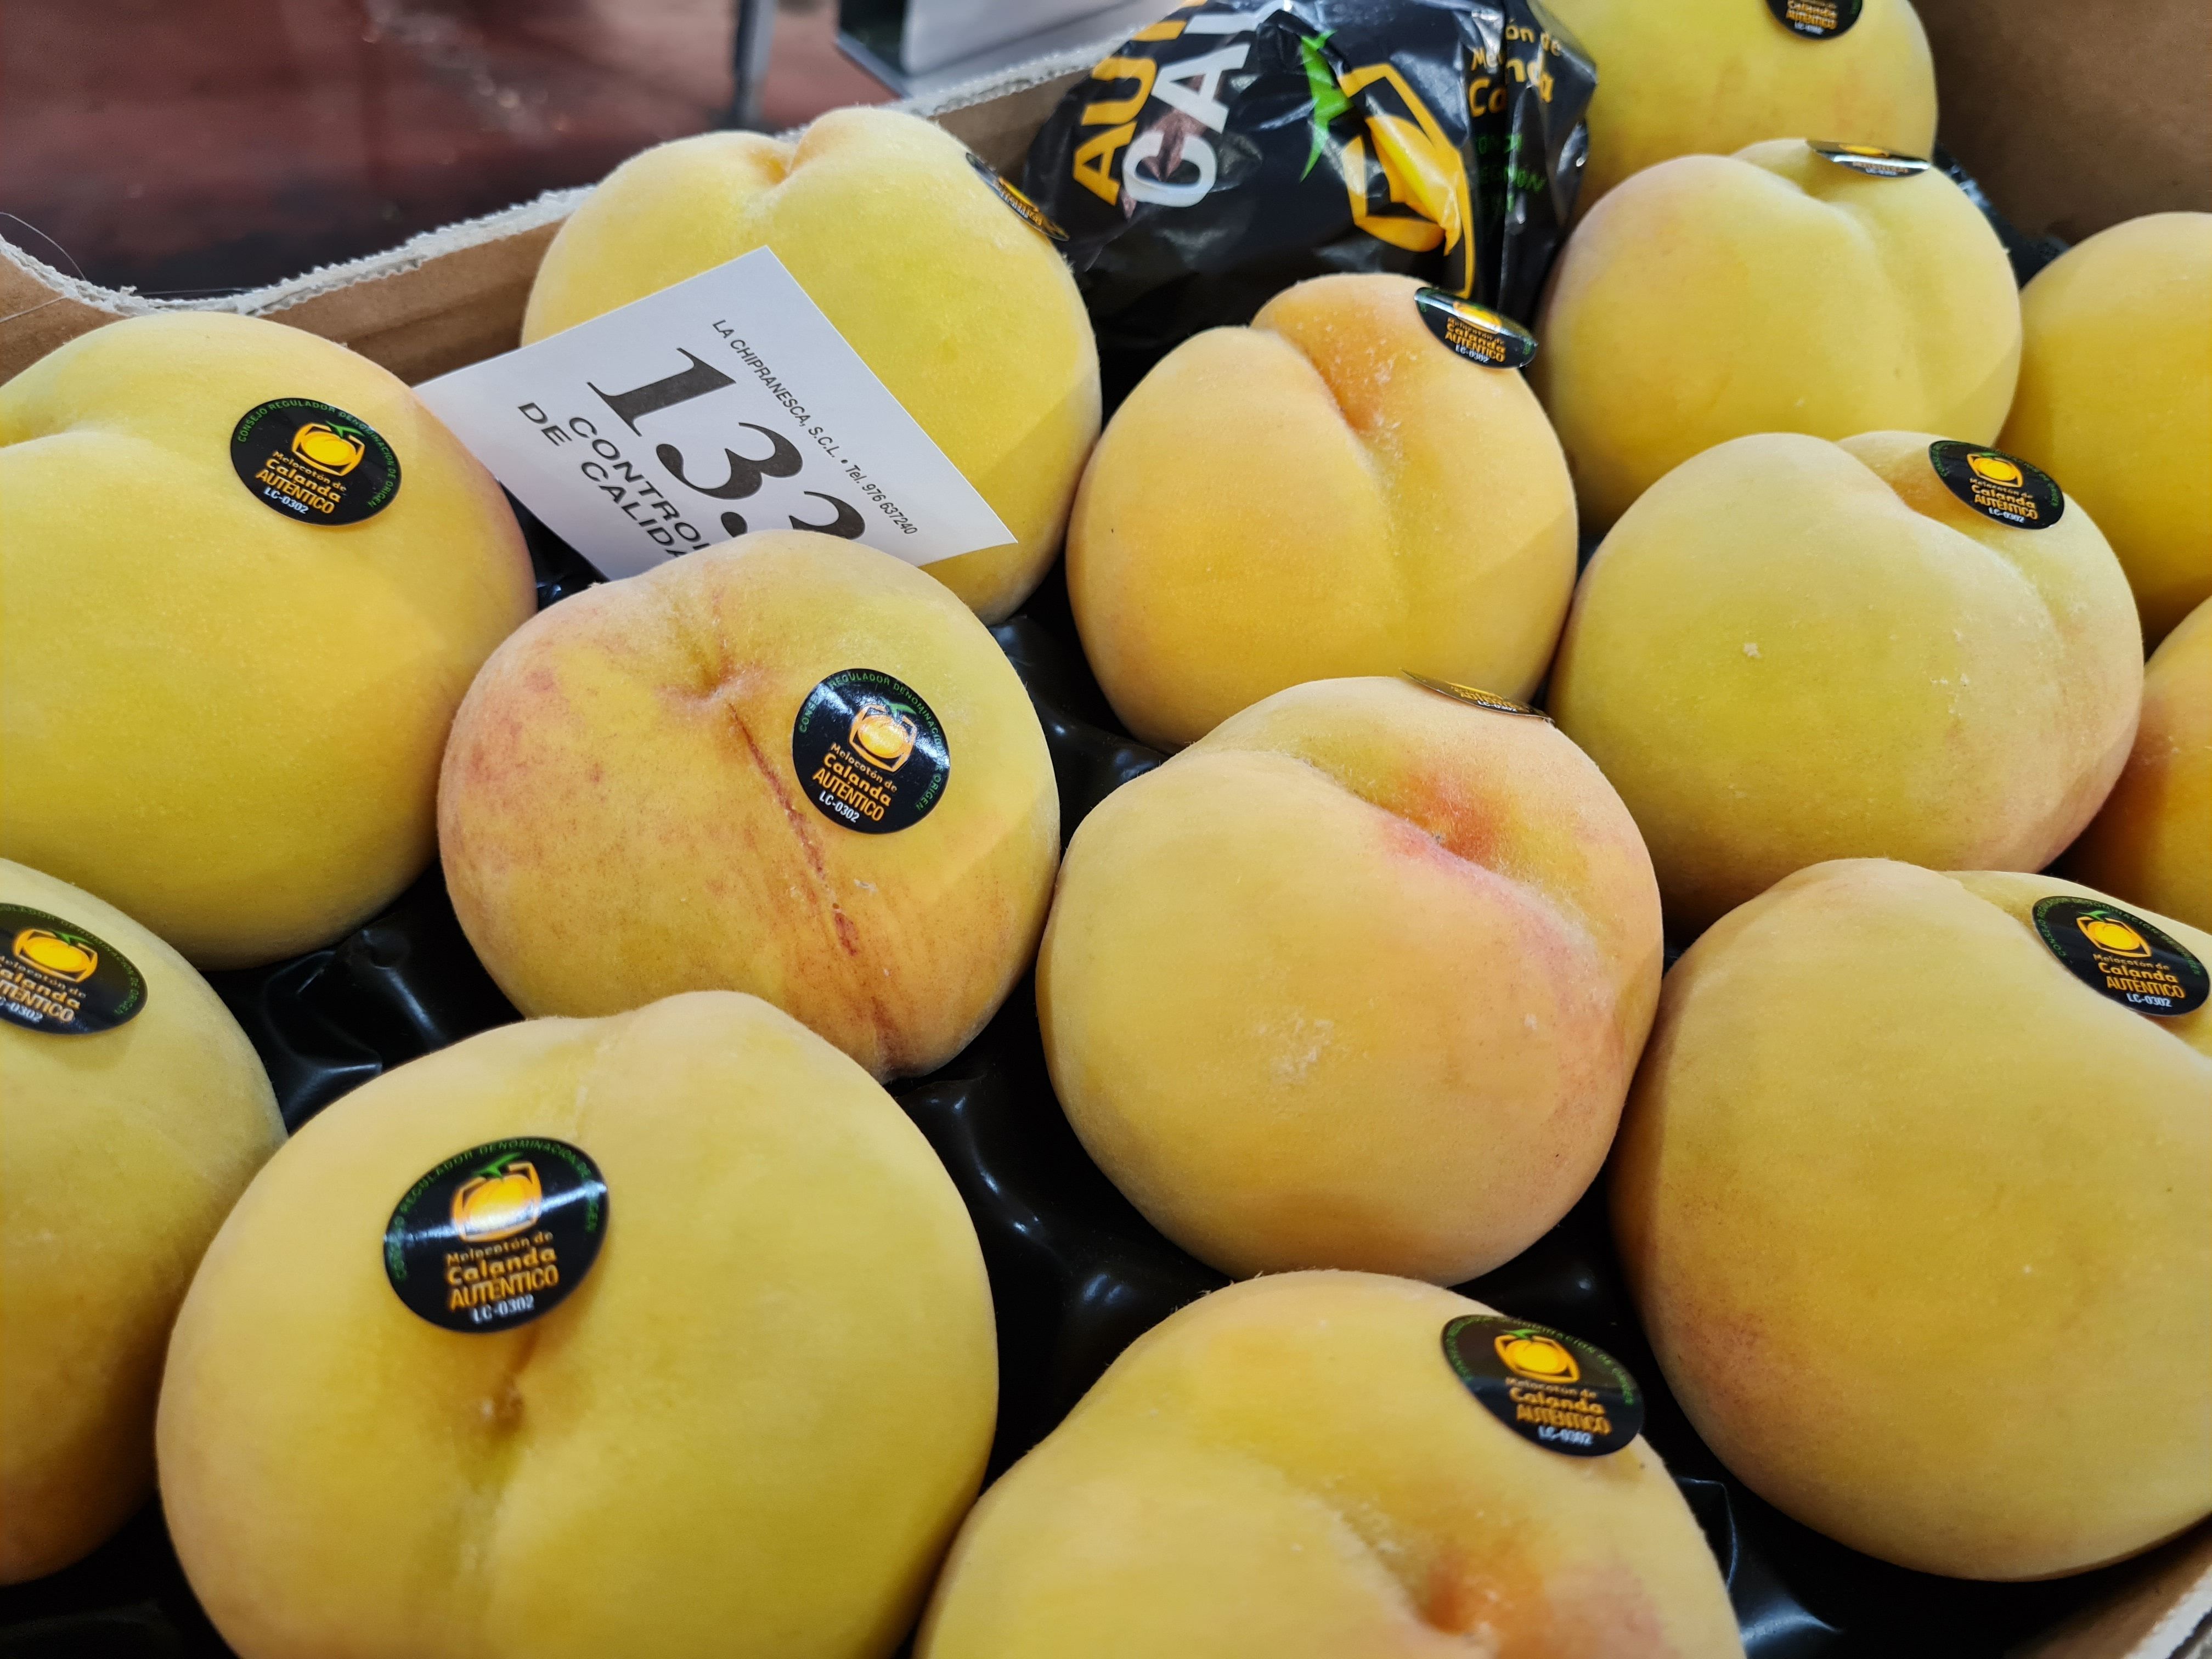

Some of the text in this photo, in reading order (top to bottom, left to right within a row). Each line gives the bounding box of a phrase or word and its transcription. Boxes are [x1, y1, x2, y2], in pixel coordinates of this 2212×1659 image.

[1446, 323, 1506, 353] Calanda
[518, 402, 573, 447] DE
[713, 319, 918, 535] LA CHIPRANESCA, S.C.L. Tel. 976 637240
[238, 408, 268, 443] CONSEJO
[269, 400, 335, 413] REGULADOR
[367, 481, 394, 508] ORIGEN
[273, 450, 347, 492] Melocotón de
[266, 458, 341, 503] Calanda
[1971, 484, 2036, 509] Calanda
[263, 487, 309, 515] LC-0302
[828, 672, 890, 688] REGULADOR
[916, 774, 942, 811] ORIGEN
[823, 753, 891, 807] Calanda
[830, 742, 898, 793] Melocotón de
[819, 791, 860, 823] LC-0302
[2092, 953, 2155, 970] Melocotón
[2097, 962, 2180, 983] Calanda
[0, 964, 81, 1009] alanda
[2126, 992, 2172, 1007] LC-0302
[447, 1248, 557, 1286] Calanda
[471, 1293, 535, 1324] LC-0302
